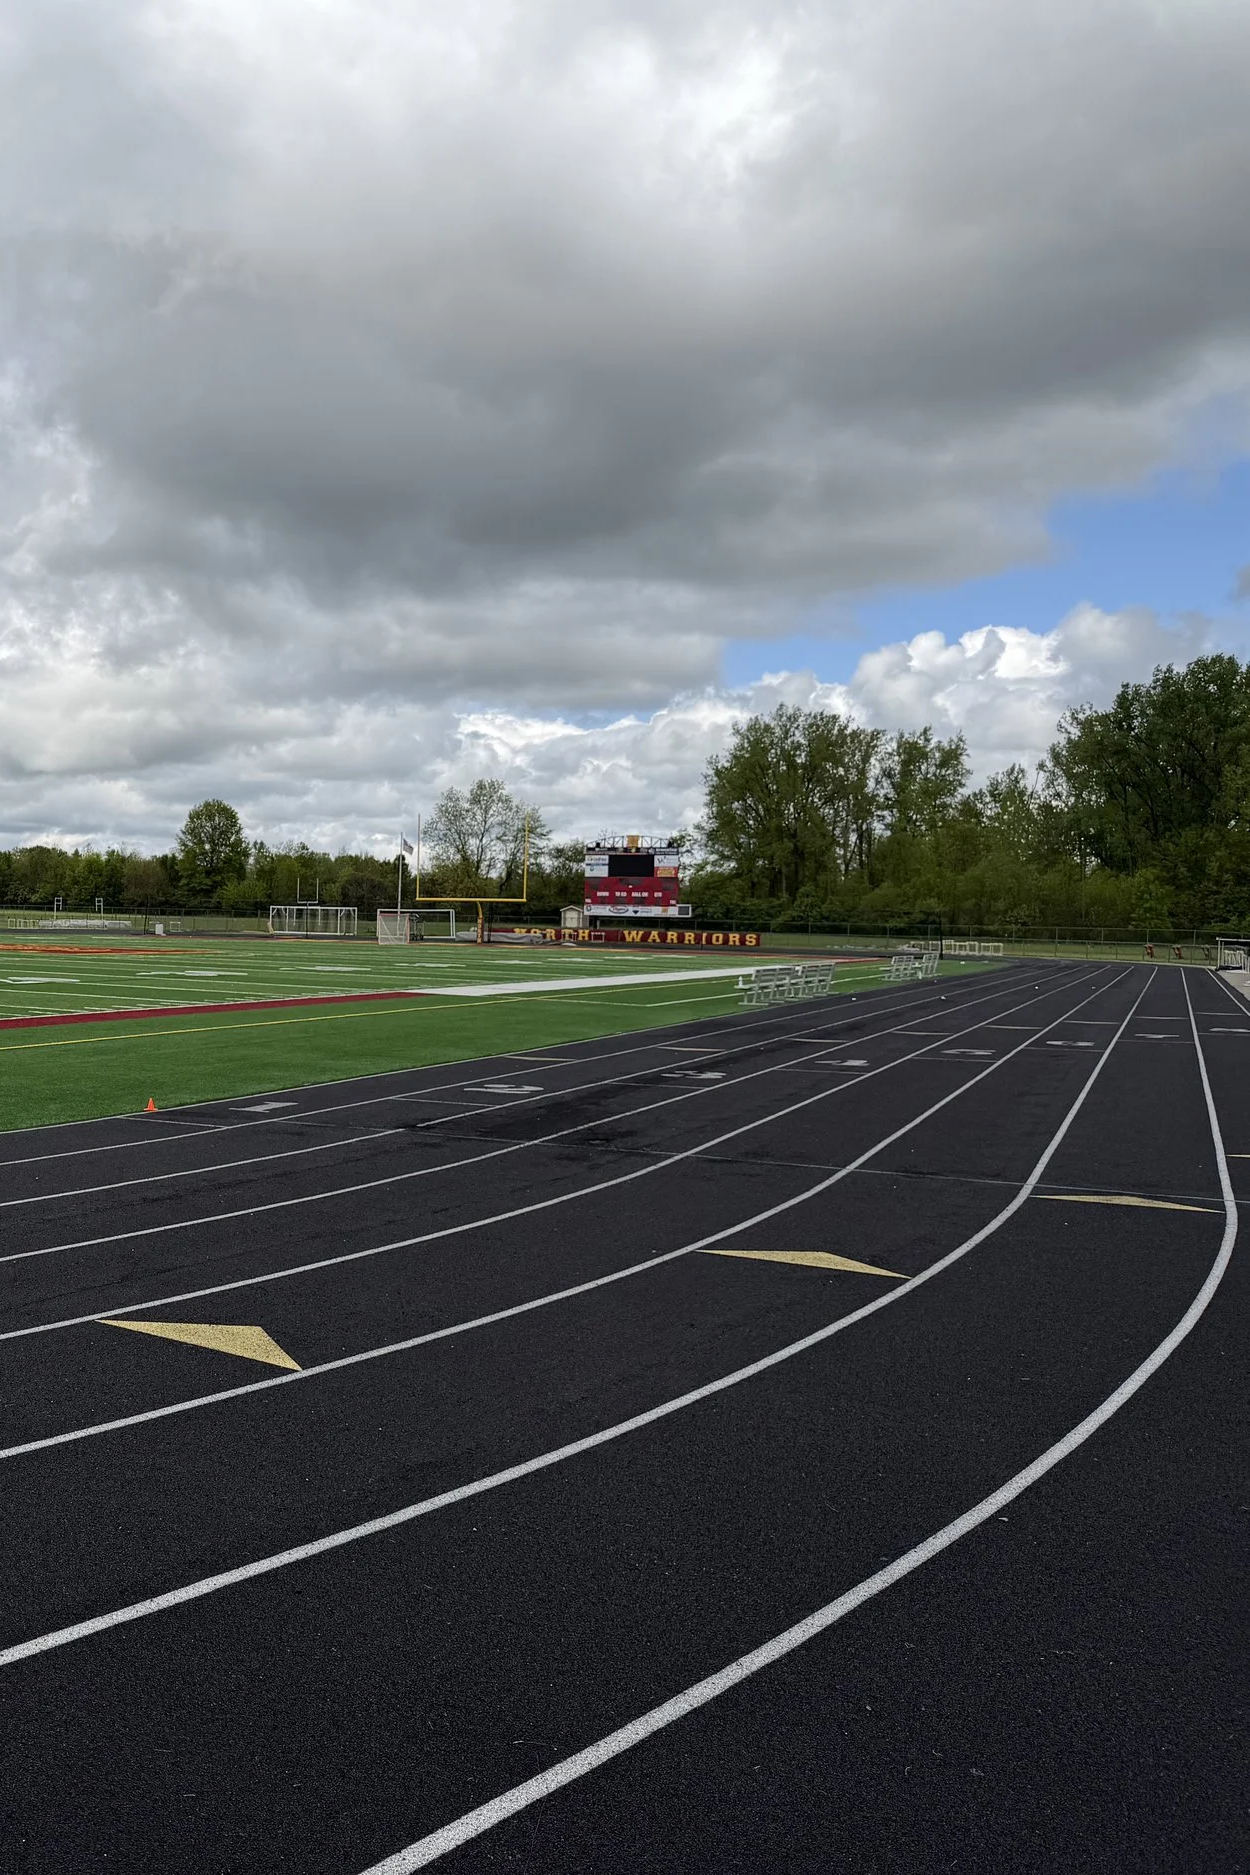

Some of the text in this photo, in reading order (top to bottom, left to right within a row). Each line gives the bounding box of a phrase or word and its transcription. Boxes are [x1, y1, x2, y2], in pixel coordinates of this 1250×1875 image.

[623, 930, 757, 946] WARRIORS
[463, 1083, 544, 1094] 2
[228, 1101, 299, 1113] 1
